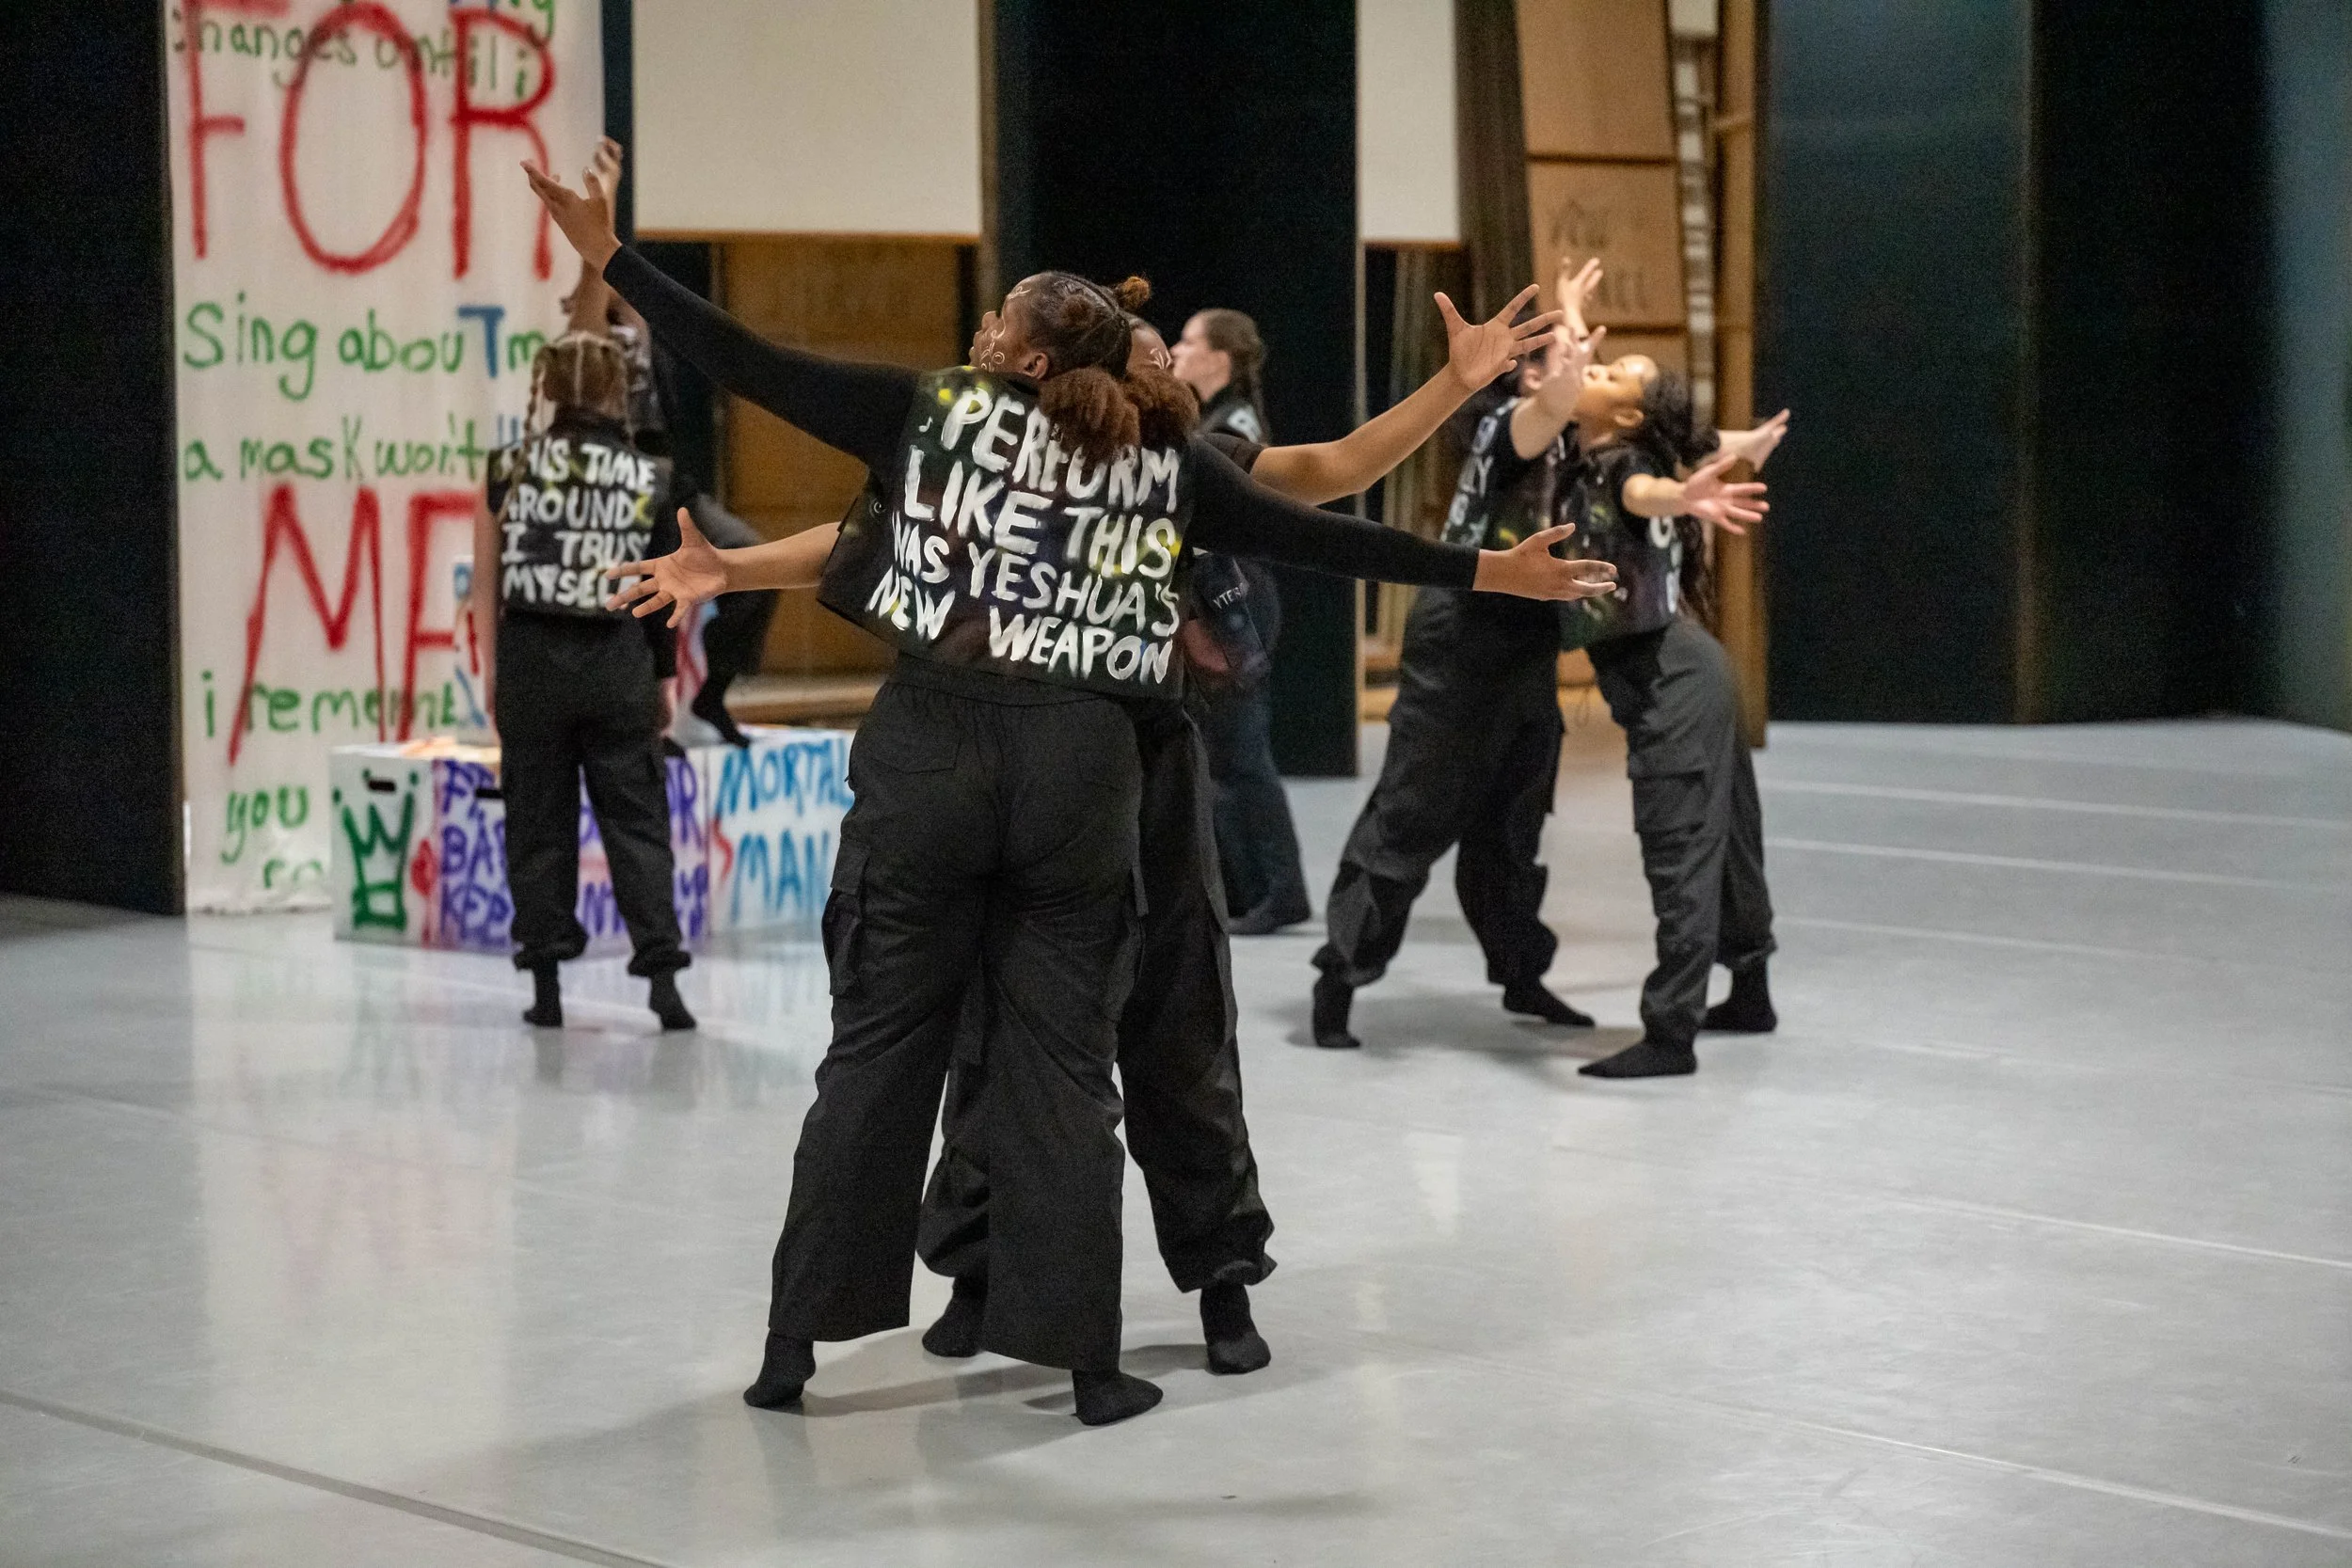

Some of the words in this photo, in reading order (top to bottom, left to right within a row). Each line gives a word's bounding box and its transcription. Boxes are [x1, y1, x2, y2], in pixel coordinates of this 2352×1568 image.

[181, 0, 557, 280] FOR
[184, 291, 318, 402] Sing
[185, 438, 223, 481] a
[580, 442, 658, 495] TIME
[501, 522, 528, 563] I
[904, 444, 1053, 555] LIKE
[1063, 506, 1176, 578] THIS
[892, 511, 950, 584] WAS
[968, 542, 1180, 637] YESHUA'S
[866, 565, 955, 641] NEW
[990, 606, 1174, 685] WEAPON
[201, 669, 215, 737] i
[220, 784, 310, 865] you
